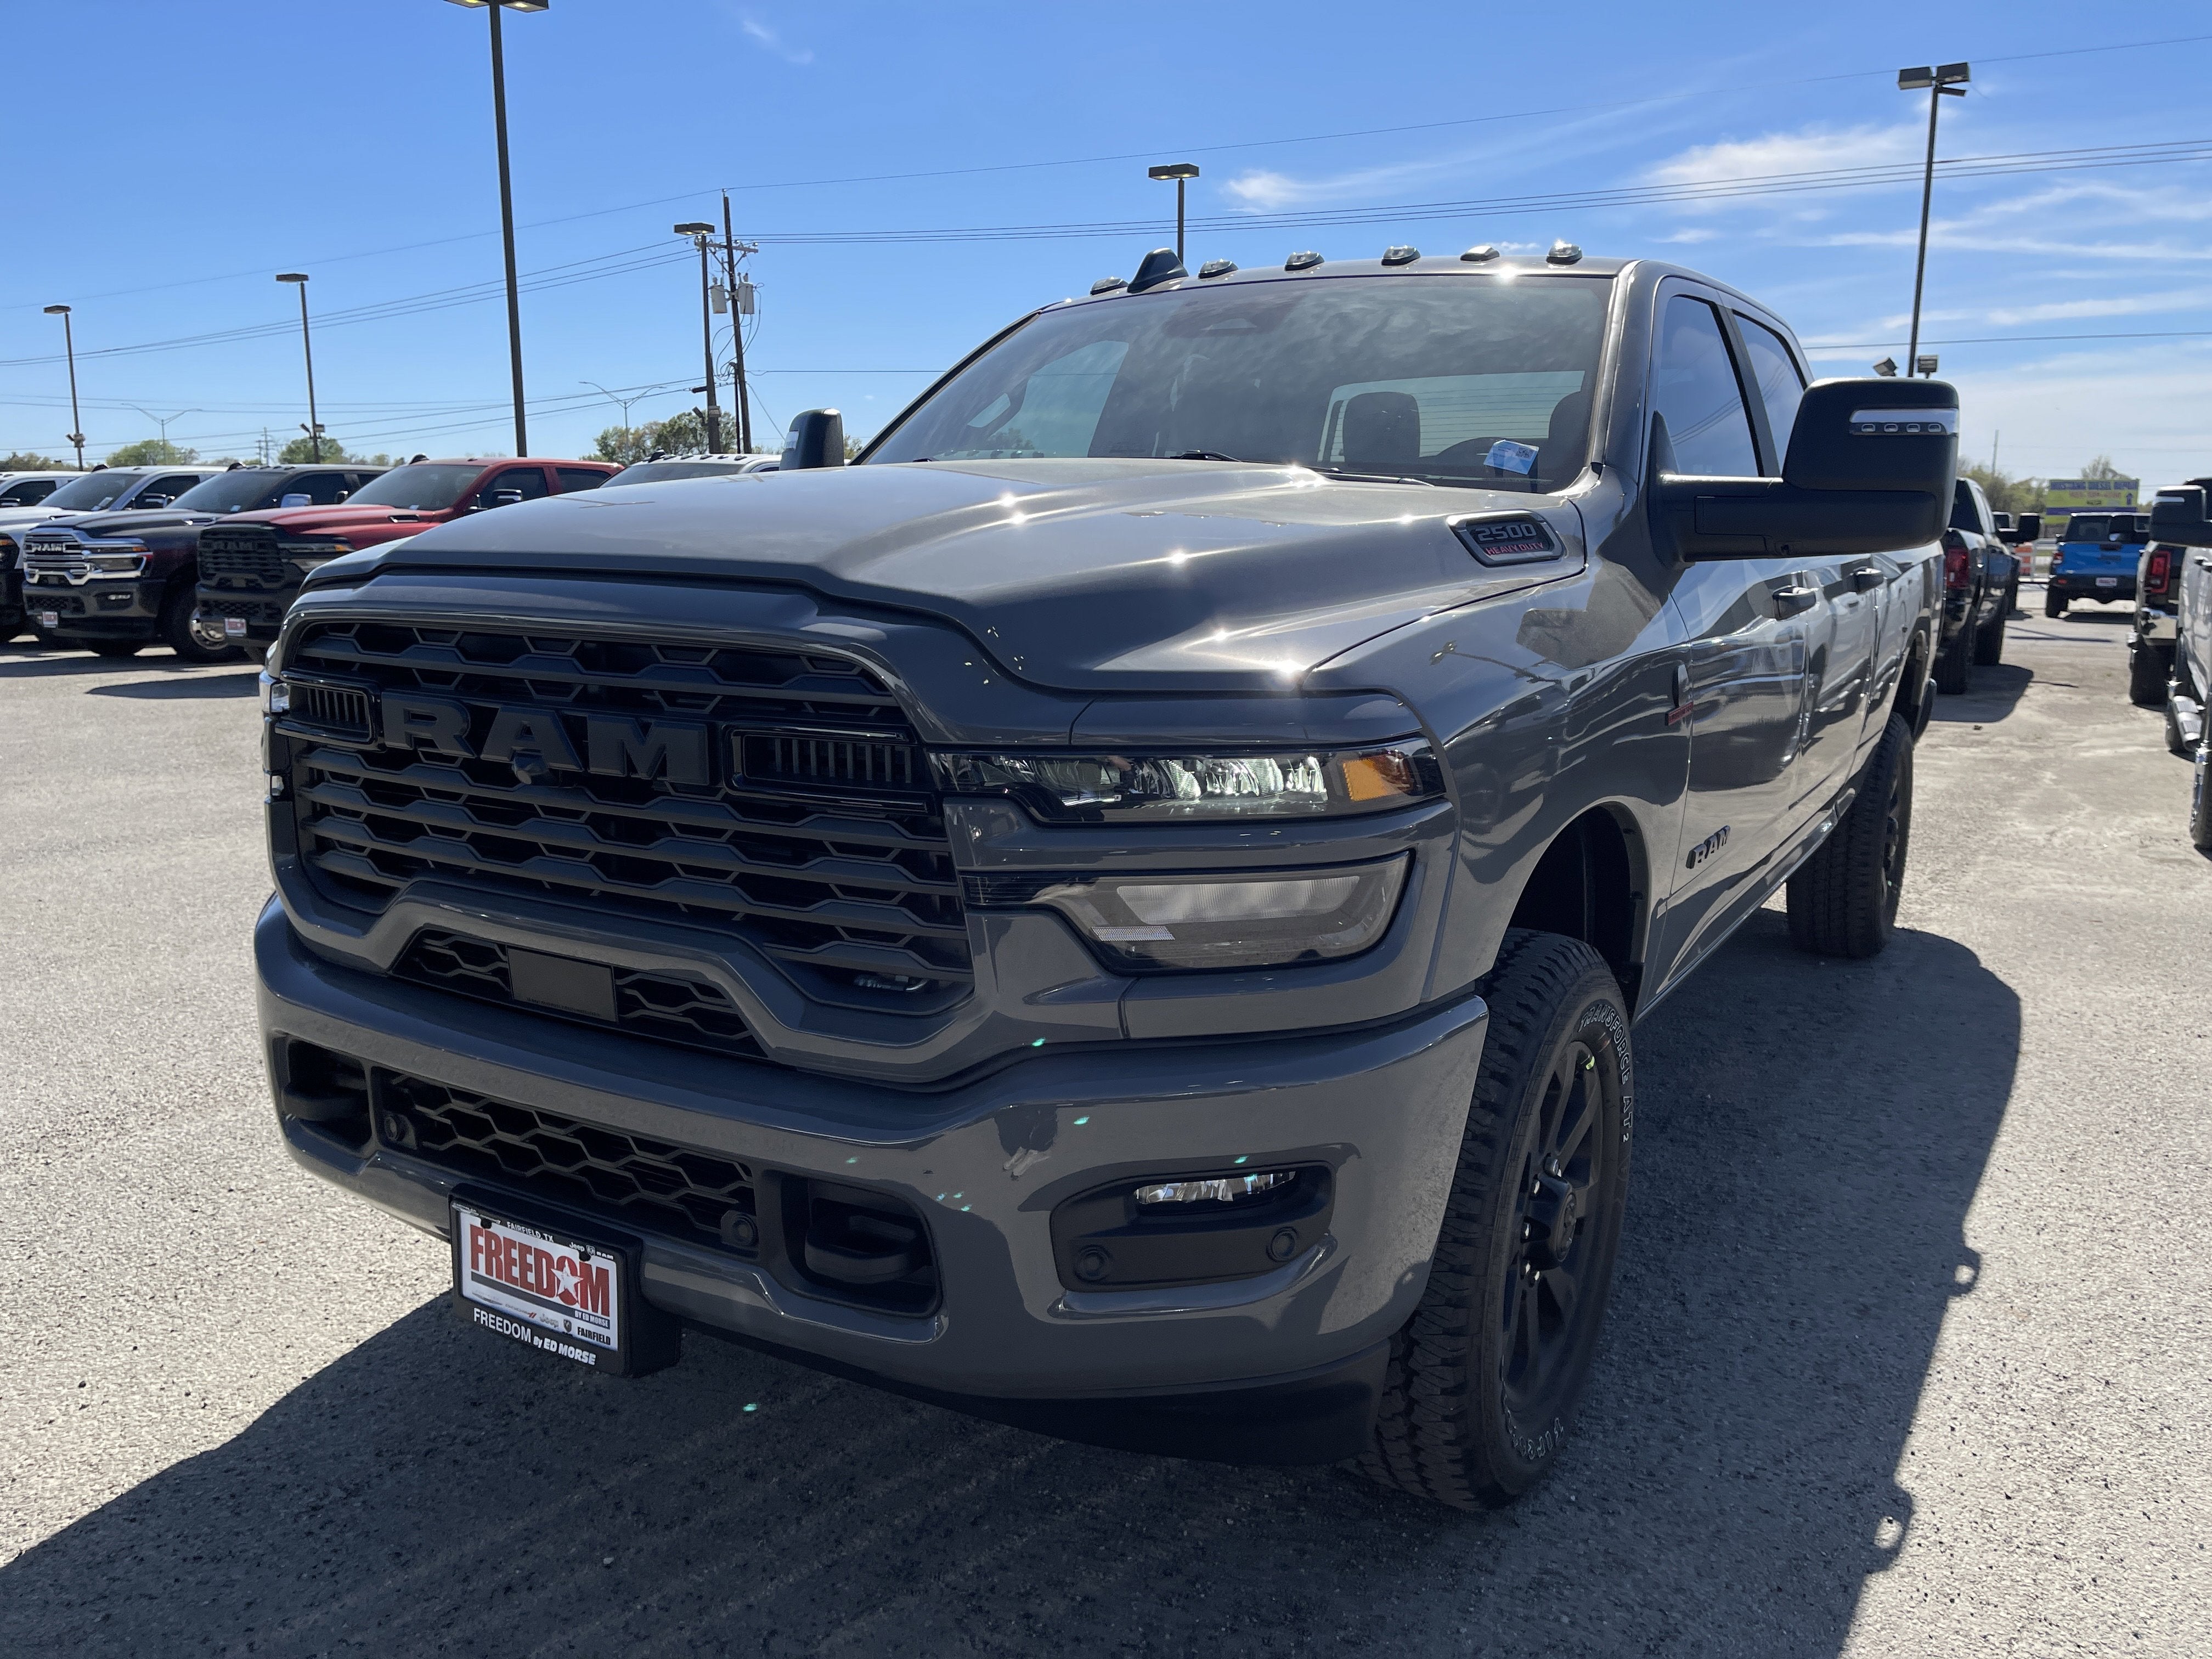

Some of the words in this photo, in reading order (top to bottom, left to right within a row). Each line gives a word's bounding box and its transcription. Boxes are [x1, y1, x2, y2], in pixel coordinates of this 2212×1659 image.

[1475, 523, 1537, 542] 2500
[31, 543, 63, 552] RAM
[1485, 544, 1518, 556] HEAVY
[1519, 542, 1544, 552] DUTY
[381, 690, 712, 786] RAM
[1685, 825, 1731, 870] RAM
[1578, 1003, 1632, 1086] TRANSFORCE
[543, 1233, 554, 1243] TX
[569, 1242, 585, 1252] Jeep
[469, 1223, 611, 1317] FREEDOM
[574, 1310, 582, 1319] BY
[582, 1312, 590, 1322] ED
[590, 1315, 609, 1328] MORSE
[473, 1307, 532, 1344] FREEDOM
[543, 1338, 557, 1353] ED
[558, 1343, 596, 1365] MORSE
[577, 1326, 611, 1346] FAIRFIELD
